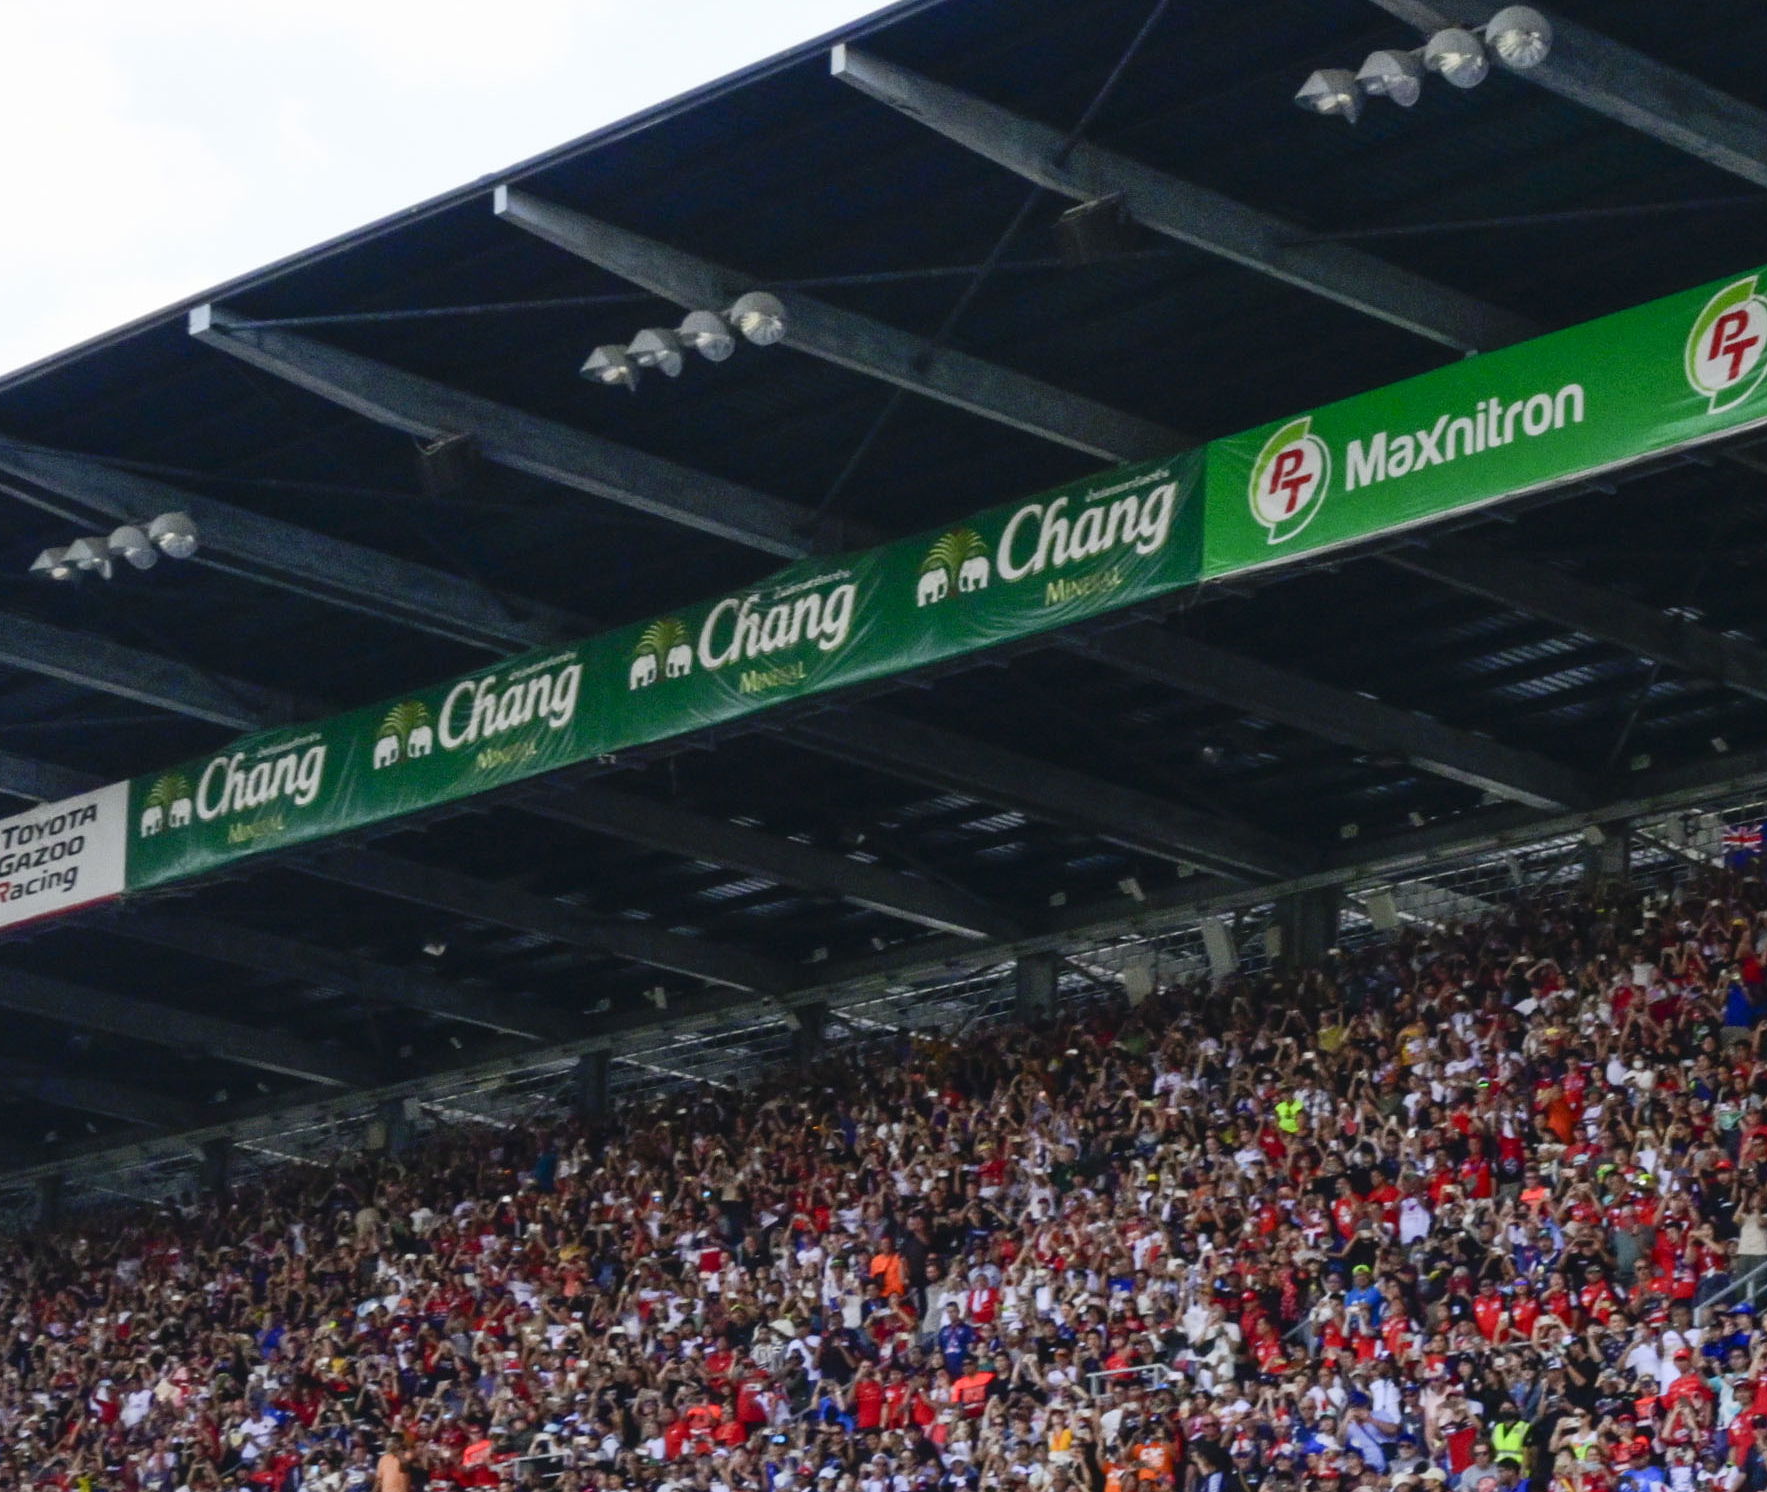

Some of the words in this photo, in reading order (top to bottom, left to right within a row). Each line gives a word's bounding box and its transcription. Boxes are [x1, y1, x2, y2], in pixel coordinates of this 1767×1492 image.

[1345, 383, 1585, 492] Maxnitron
[997, 481, 1178, 580] Chang
[696, 581, 857, 673] Chang
[438, 662, 582, 752] Chang
[2, 804, 98, 850] TOYOTA
[195, 739, 326, 825] Chang
